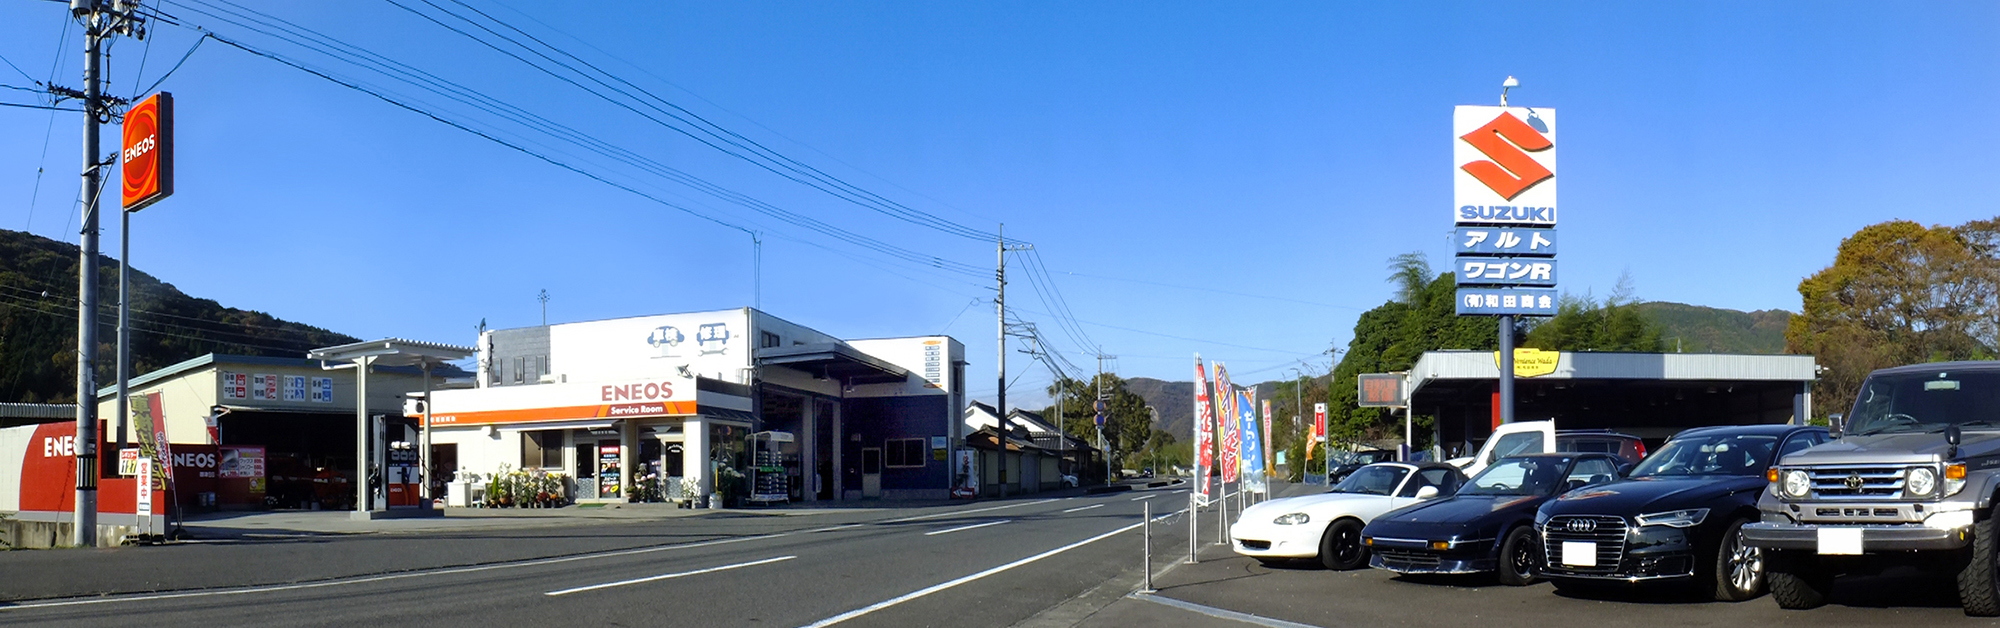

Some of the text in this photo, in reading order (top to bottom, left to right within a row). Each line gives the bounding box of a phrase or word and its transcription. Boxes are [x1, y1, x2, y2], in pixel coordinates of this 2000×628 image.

[124, 133, 155, 164] ENEOS
[1460, 205, 1554, 221] SUZUKI
[1464, 231, 1551, 250] アルト
[1464, 262, 1552, 280] ワゴンR
[601, 381, 674, 402] ENEOS
[610, 404, 664, 415] Service Room
[44, 435, 78, 458] ENE
[170, 453, 216, 468] NEOS
